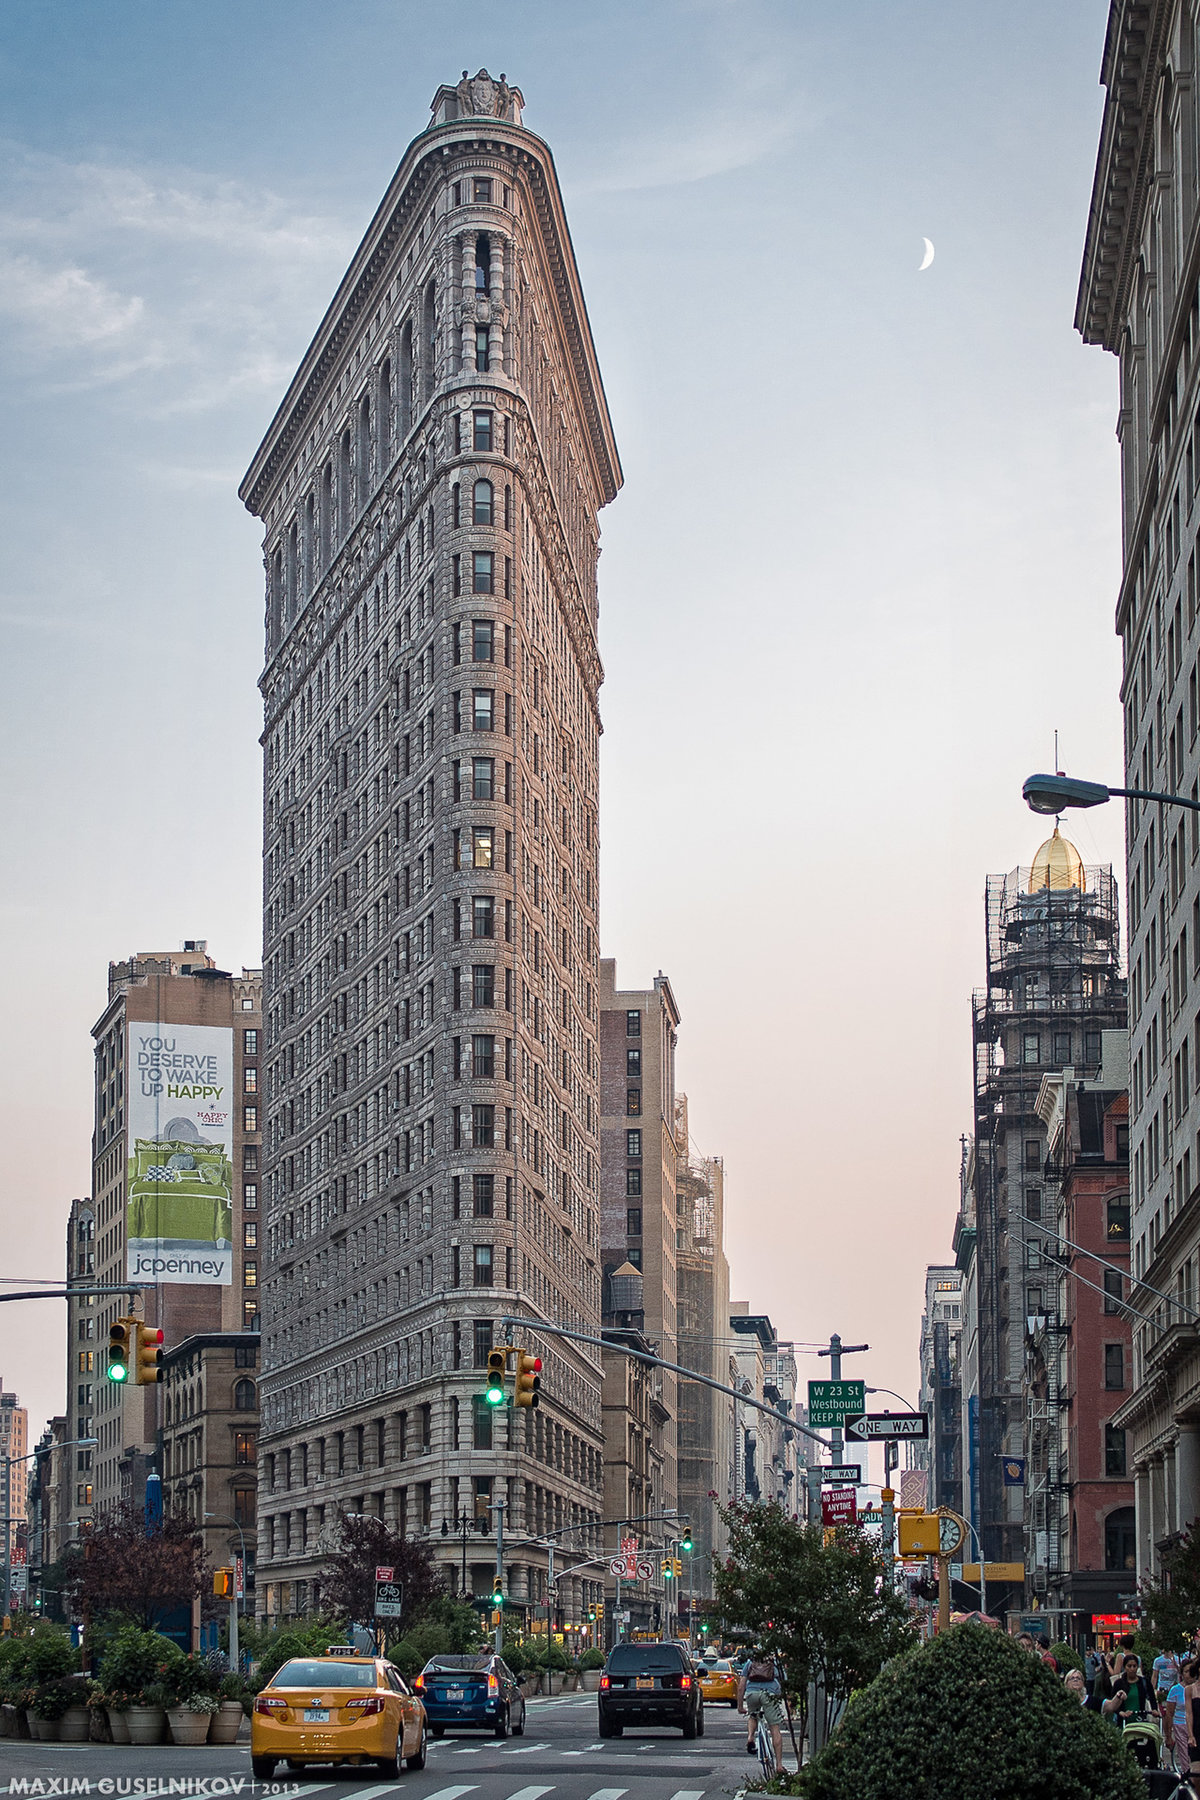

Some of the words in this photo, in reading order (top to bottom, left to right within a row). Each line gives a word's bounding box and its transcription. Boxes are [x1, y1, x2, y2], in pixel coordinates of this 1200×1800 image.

[139, 1037, 176, 1052] YOU
[138, 1052, 217, 1070] DESERVE
[138, 1067, 163, 1082] TO
[166, 1069, 217, 1085] WAKE
[141, 1083, 164, 1097] UP
[167, 1084, 224, 1100] HAPPY
[133, 1253, 224, 1278] jcpenney
[813, 1386, 824, 1396] W
[829, 1386, 842, 1396] 23
[847, 1386, 859, 1396] St
[810, 1399, 863, 1409] Westbound
[811, 1412, 833, 1422] KEEP
[857, 1422, 881, 1433] ONE
[892, 1421, 917, 1433] WAY
[823, 1470, 833, 1479] NE
[839, 1470, 854, 1479] WAY
[822, 1494, 831, 1502] NO
[832, 1491, 854, 1502] STANDING
[827, 1502, 852, 1512] ANYTIME
